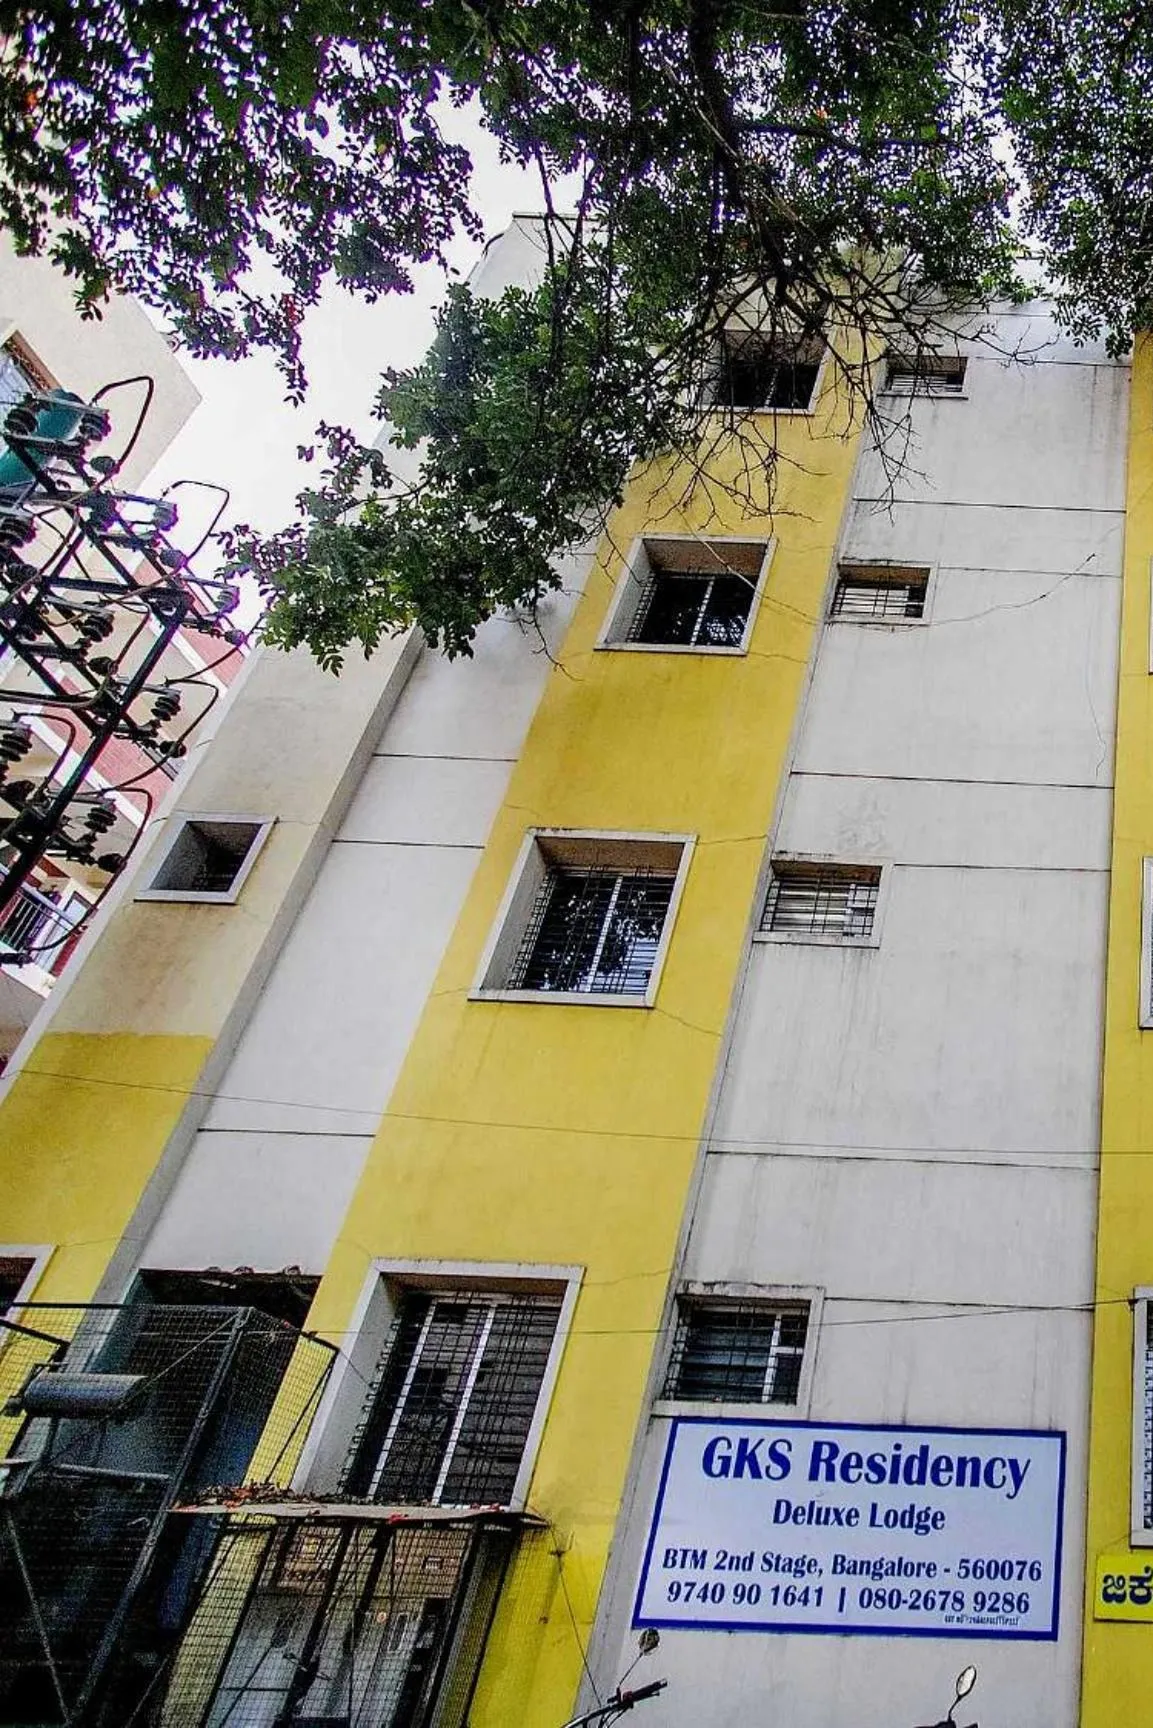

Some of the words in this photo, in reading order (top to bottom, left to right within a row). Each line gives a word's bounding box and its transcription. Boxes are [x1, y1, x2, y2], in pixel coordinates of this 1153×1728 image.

[702, 1436, 792, 1481] GKS
[808, 1440, 1031, 1499] Residency
[773, 1499, 860, 1527] Deluxe
[869, 1503, 946, 1535] Lodge
[662, 1548, 708, 1570] BTM
[713, 1550, 755, 1572] 2nd
[760, 1551, 824, 1578] Stage,
[831, 1554, 937, 1581] Bangalore
[957, 1559, 1042, 1582] 560076
[667, 1581, 725, 1604] 9740
[732, 1583, 761, 1605] 90
[770, 1584, 824, 1607] 1641
[859, 1587, 965, 1612] 080-2678
[973, 1591, 1030, 1614] 9286
